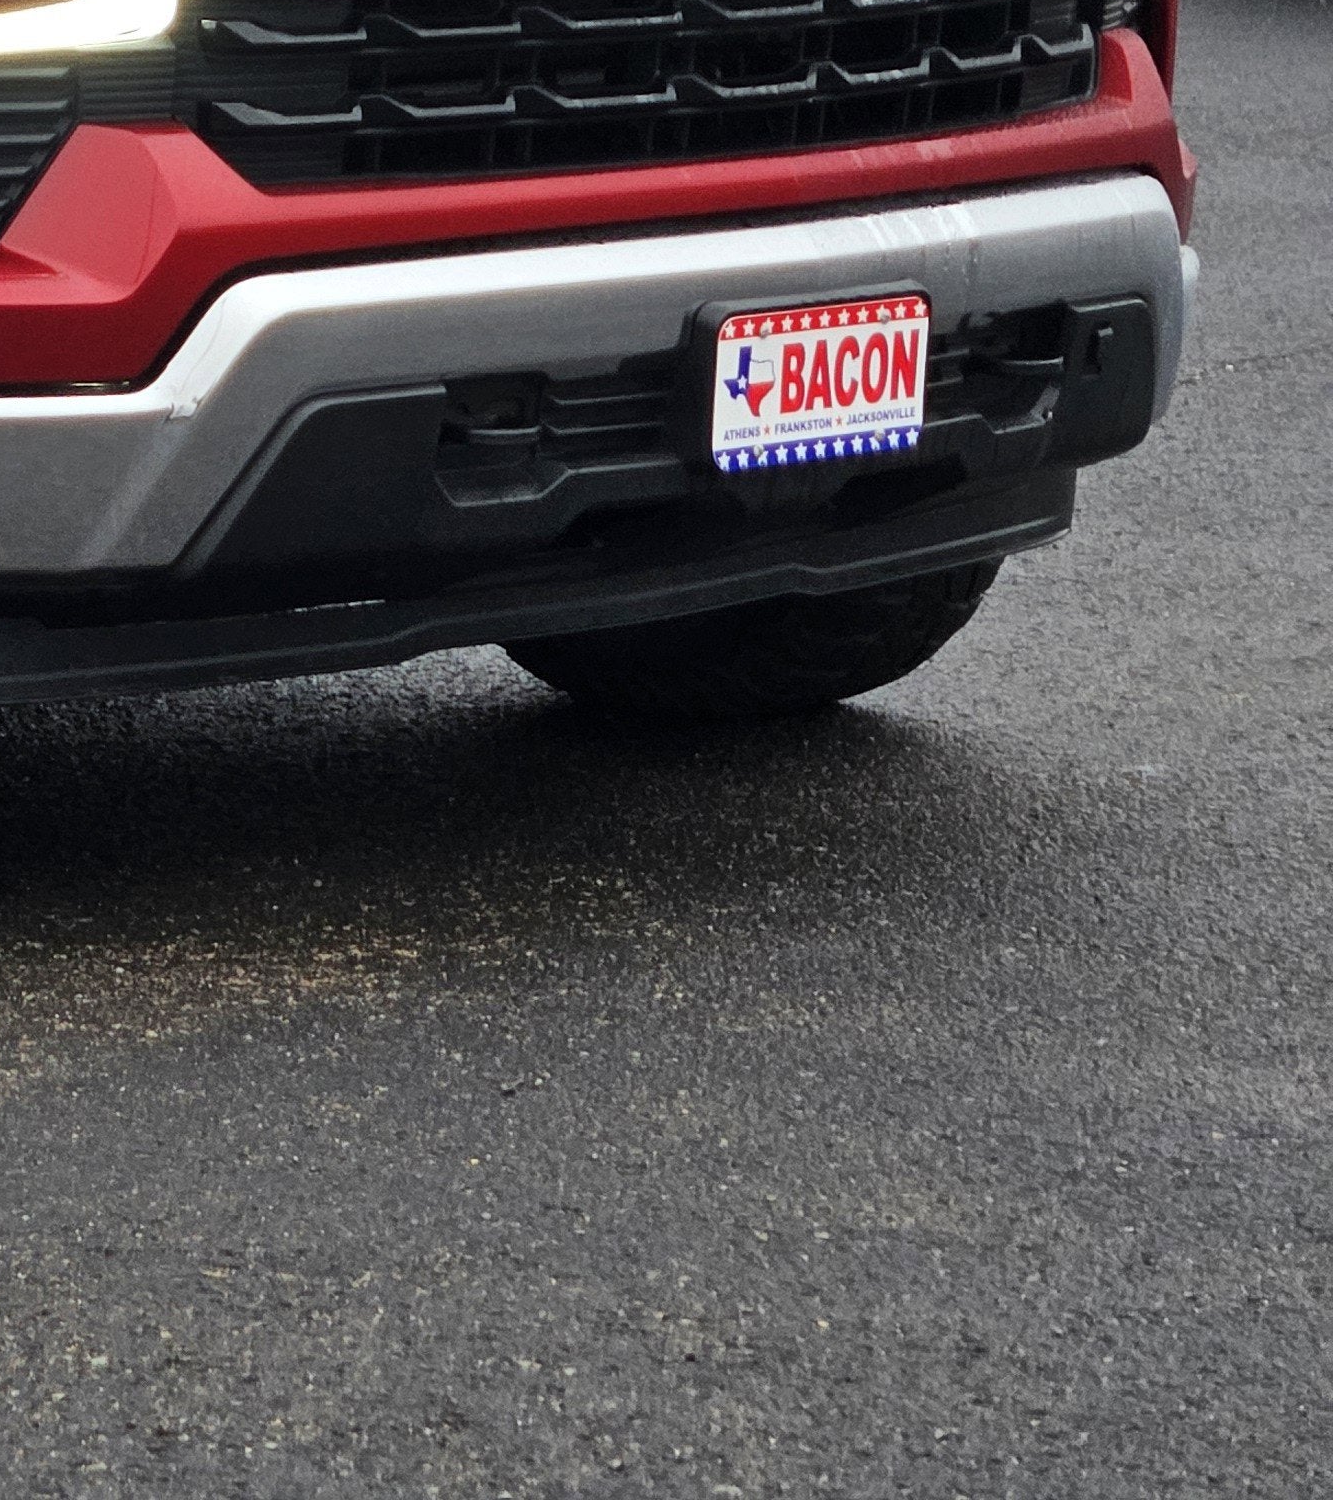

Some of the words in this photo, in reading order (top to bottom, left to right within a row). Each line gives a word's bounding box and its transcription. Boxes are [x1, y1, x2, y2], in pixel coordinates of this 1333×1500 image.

[779, 328, 921, 415] BACON
[723, 426, 762, 442] ATHENS
[774, 417, 833, 436] FRANKSTON
[846, 406, 916, 426] JACKSONVILLE
